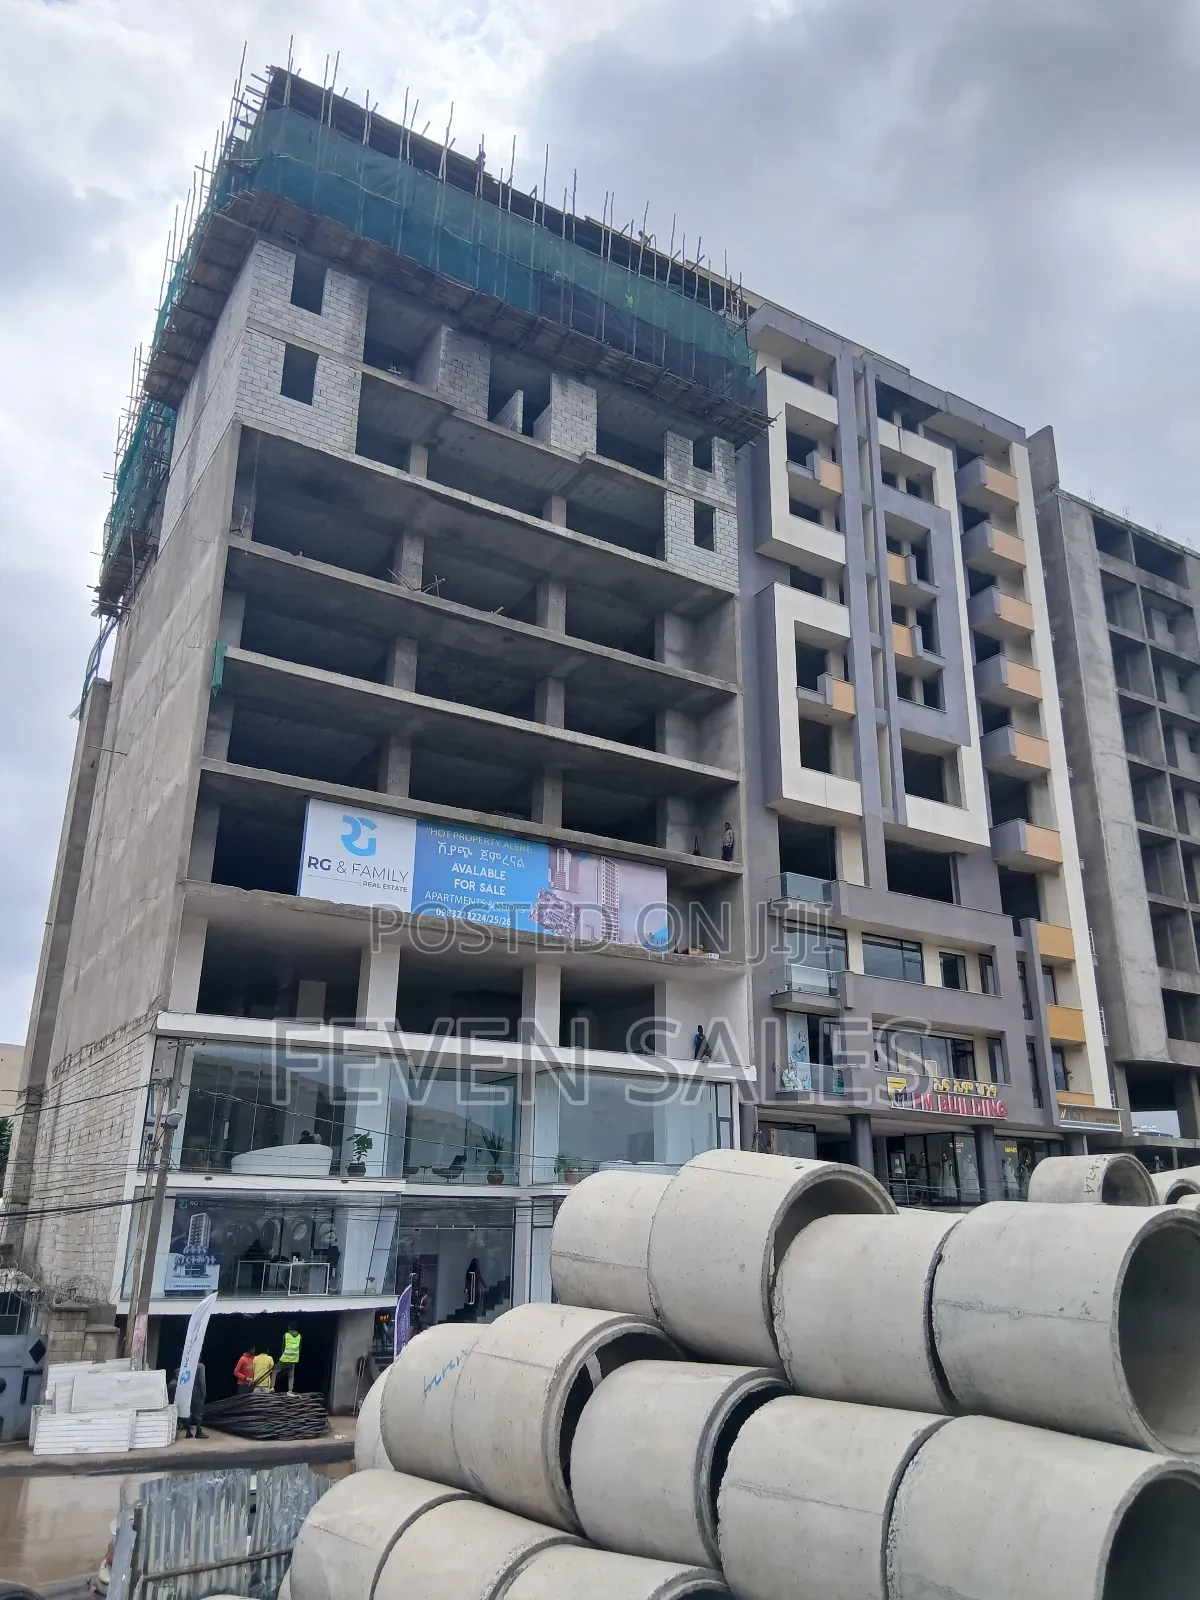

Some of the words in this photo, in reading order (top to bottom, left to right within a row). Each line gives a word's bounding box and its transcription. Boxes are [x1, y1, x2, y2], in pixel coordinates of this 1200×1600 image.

[453, 831, 502, 848] PROPERTY
[437, 840, 473, 859] ሽያጭ
[479, 848, 526, 869] ጀምረናል
[307, 855, 332, 871] RG
[336, 860, 347, 874] &
[351, 862, 409, 883] FAMILY
[451, 862, 507, 881] AVALABLE
[362, 880, 382, 890] REAL
[382, 883, 408, 893] ESTATE
[454, 878, 477, 892] FOR
[479, 882, 506, 897] SALE
[424, 890, 487, 909] APARTMENTS
[487, 899, 495, 909] &
[495, 901, 526, 914] SHOPS
[936, 1095, 1008, 1118] BUILDING
